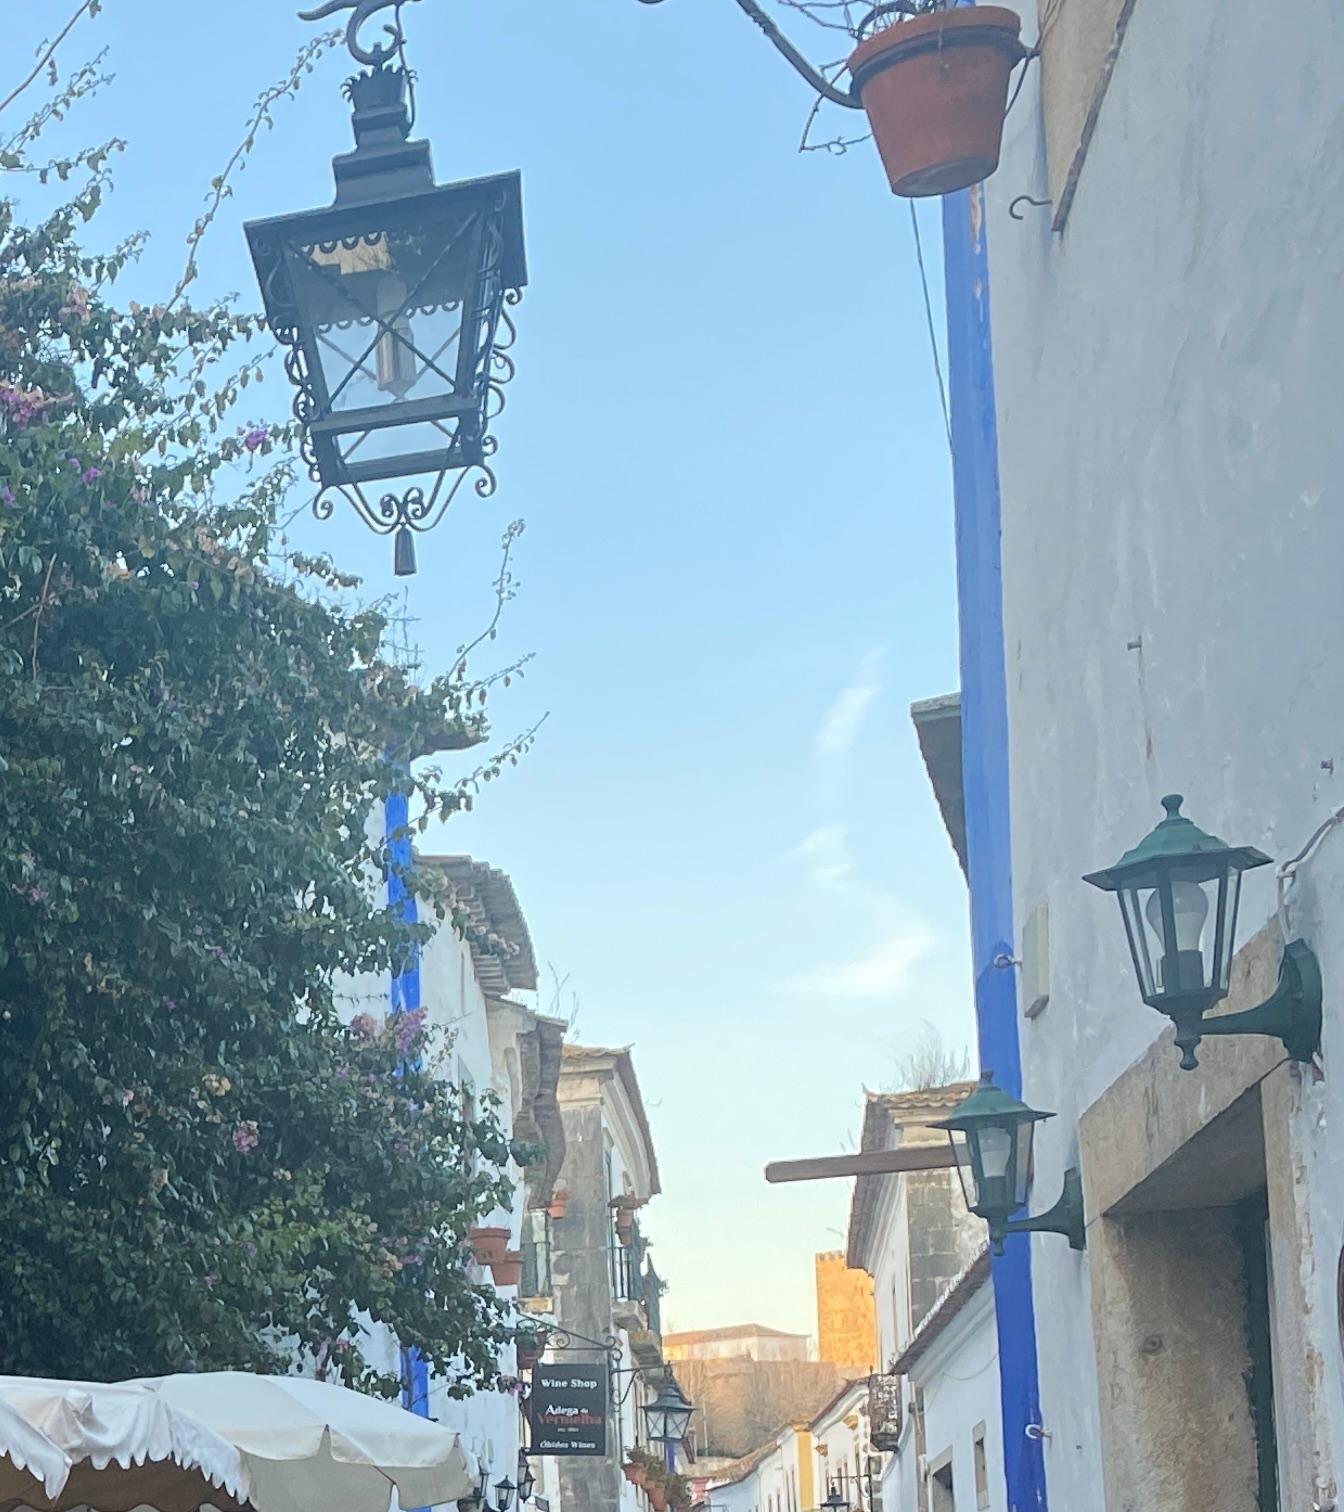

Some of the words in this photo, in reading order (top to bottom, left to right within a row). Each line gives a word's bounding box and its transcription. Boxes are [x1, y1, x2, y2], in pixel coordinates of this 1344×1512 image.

[540, 1378, 568, 1388] Wine
[570, 1378, 598, 1389] Shop
[545, 1404, 579, 1417] Adega
